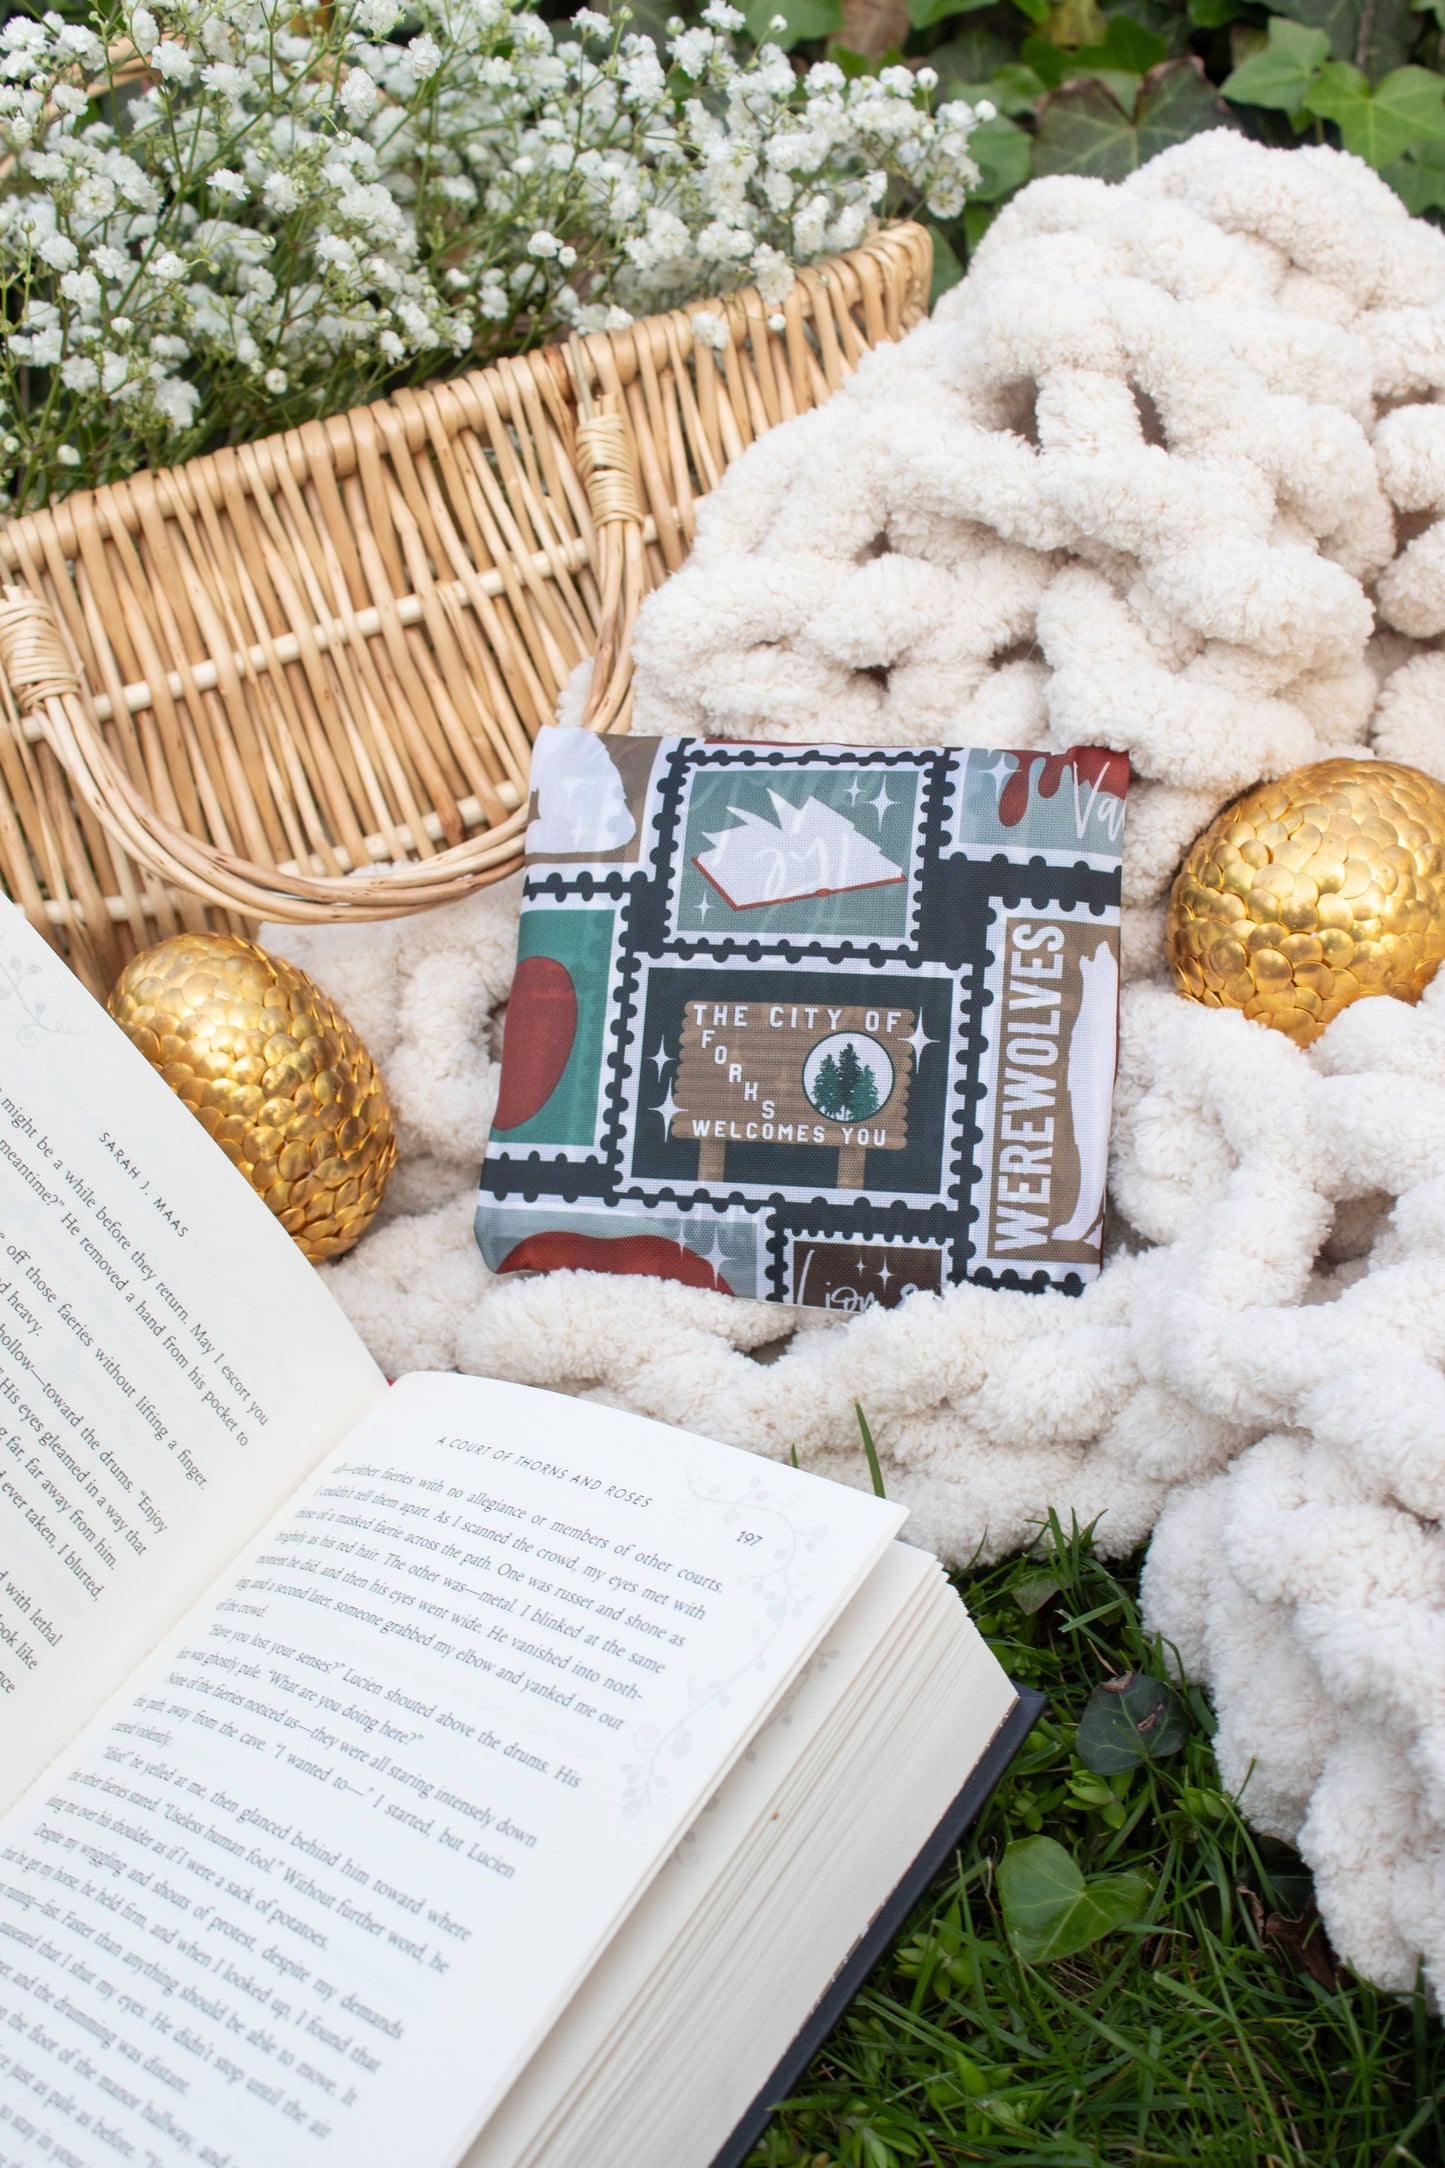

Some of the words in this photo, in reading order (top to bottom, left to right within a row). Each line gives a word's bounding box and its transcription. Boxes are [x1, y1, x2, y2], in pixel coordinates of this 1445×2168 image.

[693, 1004, 749, 1027] THE
[769, 1006, 843, 1031] CITY
[865, 1010, 902, 1033] OF
[692, 1119, 825, 1143] WELCOMES
[841, 1127, 886, 1147] YOU
[994, 923, 1065, 1251] WEREWOLVES
[99, 1132, 140, 1179] SARAH
[139, 1180, 150, 1196] J.
[153, 1197, 188, 1237] MAAS
[2, 1098, 37, 1138] might
[36, 1136, 54, 1158] be
[53, 1159, 64, 1171] a
[65, 1170, 96, 1208] while
[96, 1206, 131, 1250] before
[130, 1251, 157, 1282] they
[155, 1282, 188, 1325] return.
[190, 1323, 215, 1355] May
[213, 1352, 225, 1364] I
[221, 1365, 251, 1402] escort
[246, 1401, 268, 1426] you
[7, 1290, 42, 1336] heavy.
[6, 1245, 31, 1265] off
[25, 1266, 57, 1303] those
[57, 1303, 94, 1347] faeries
[95, 1348, 136, 1398] without
[135, 1396, 168, 1441] lifting
[167, 1440, 178, 1451] a
[177, 1449, 207, 1490] finger.
[60, 1212, 80, 1236] He
[80, 1237, 129, 1291] removed
[125, 1292, 136, 1303] a
[135, 1302, 167, 1337] hand
[162, 1335, 188, 1369] from
[187, 1366, 206, 1390] his
[201, 1390, 238, 1432] pocket
[236, 1431, 248, 1447] to
[0, 1378, 20, 1404] His
[18, 1404, 44, 1432] eyes
[38, 1432, 90, 1483] gleamed
[84, 1479, 99, 1498] in
[96, 1496, 107, 1508] a
[106, 1504, 128, 1533] way
[125, 1530, 147, 1556] that
[6, 1435, 25, 1462] far,
[24, 1457, 44, 1479] far
[41, 1479, 72, 1513] away
[69, 1509, 96, 1543] from
[94, 1538, 116, 1570] him.
[80, 1427, 100, 1450] the
[99, 1451, 133, 1493] drums.
[138, 1490, 168, 1534] “Enjoy
[436, 1437, 447, 1445] A
[449, 1438, 492, 1456] COURT
[492, 1450, 514, 1461] OF
[515, 1456, 568, 1479] THORNS
[569, 1474, 602, 1490] AND
[605, 1485, 653, 1508] ROSES
[2, 1482, 28, 1509] ever
[25, 1508, 56, 1549] taken,
[56, 1543, 70, 1556] I
[64, 1550, 104, 1601] blurted,
[380, 1467, 416, 1485] faeries
[418, 1478, 444, 1493] with
[446, 1487, 464, 1499] no
[467, 1492, 527, 1519] allegiance
[530, 1514, 548, 1526] or
[550, 1522, 610, 1549] members
[613, 1544, 636, 1557] of
[634, 1552, 673, 1572] other
[677, 1569, 722, 1594] courts.
[399, 1503, 430, 1518] apart.
[432, 1510, 451, 1524] As
[451, 1515, 463, 1528] I
[461, 1522, 513, 1544] scanned
[512, 1537, 534, 1553] the
[536, 1548, 580, 1572] crowd,
[582, 1566, 607, 1583] my
[608, 1576, 639, 1593] eyes
[641, 1588, 670, 1605] met
[674, 1600, 706, 1620] with
[736, 1530, 763, 1546] 197
[5, 1582, 31, 1613] with
[29, 1608, 63, 1647] lethal
[342, 1571, 369, 1588] then
[368, 1578, 389, 1596] his
[389, 1590, 417, 1606] eyes
[418, 1600, 449, 1619] went
[451, 1613, 482, 1634] wide.
[486, 1625, 508, 1643] He
[512, 1638, 573, 1669] vanished
[571, 1660, 601, 1682] into
[602, 1677, 643, 1700] noth-
[383, 1552, 407, 1570] The
[408, 1565, 441, 1582] other
[443, 1577, 518, 1612] was—metal.
[519, 1604, 532, 1618] I
[530, 1608, 584, 1638] blinked
[583, 1634, 600, 1647] at
[601, 1639, 626, 1657] the
[628, 1652, 666, 1674] same
[404, 1533, 440, 1551] across
[440, 1543, 462, 1559] the
[459, 1553, 491, 1571] path.
[497, 1563, 525, 1582] One
[528, 1576, 553, 1593] was
[554, 1588, 595, 1610] russet
[595, 1604, 626, 1621] and
[624, 1614, 667, 1639] shone
[668, 1634, 687, 1647] as
[15, 1642, 38, 1670] like
[269, 1670, 300, 1694] “What
[297, 1687, 318, 1702] are
[314, 1695, 342, 1712] you
[341, 1704, 379, 1733] doing
[378, 1720, 424, 1745] here?”
[333, 1602, 384, 1626] someone
[380, 1621, 436, 1646] grabbed
[432, 1641, 456, 1659] my
[455, 1648, 496, 1672] elbow
[495, 1668, 526, 1685] and
[520, 1679, 576, 1707] yanked
[573, 1701, 597, 1718] me
[598, 1713, 624, 1731] out
[295, 1652, 346, 1674] senses?”
[342, 1668, 383, 1695] Lucien
[384, 1688, 438, 1718] shouted
[435, 1712, 476, 1737] above
[477, 1730, 501, 1750] the
[503, 1742, 548, 1774] drums.
[554, 1765, 582, 1788] His
[340, 1741, 370, 1763] were
[368, 1755, 392, 1772] all
[387, 1766, 434, 1799] staring
[434, 1786, 496, 1829] intensely
[495, 1818, 537, 1848] down
[372, 1794, 385, 1809] I
[384, 1804, 435, 1837] started,
[438, 1827, 465, 1851] but
[467, 1843, 516, 1879] Lucien
[372, 1880, 426, 1914] toward
[427, 1910, 472, 1942] where
